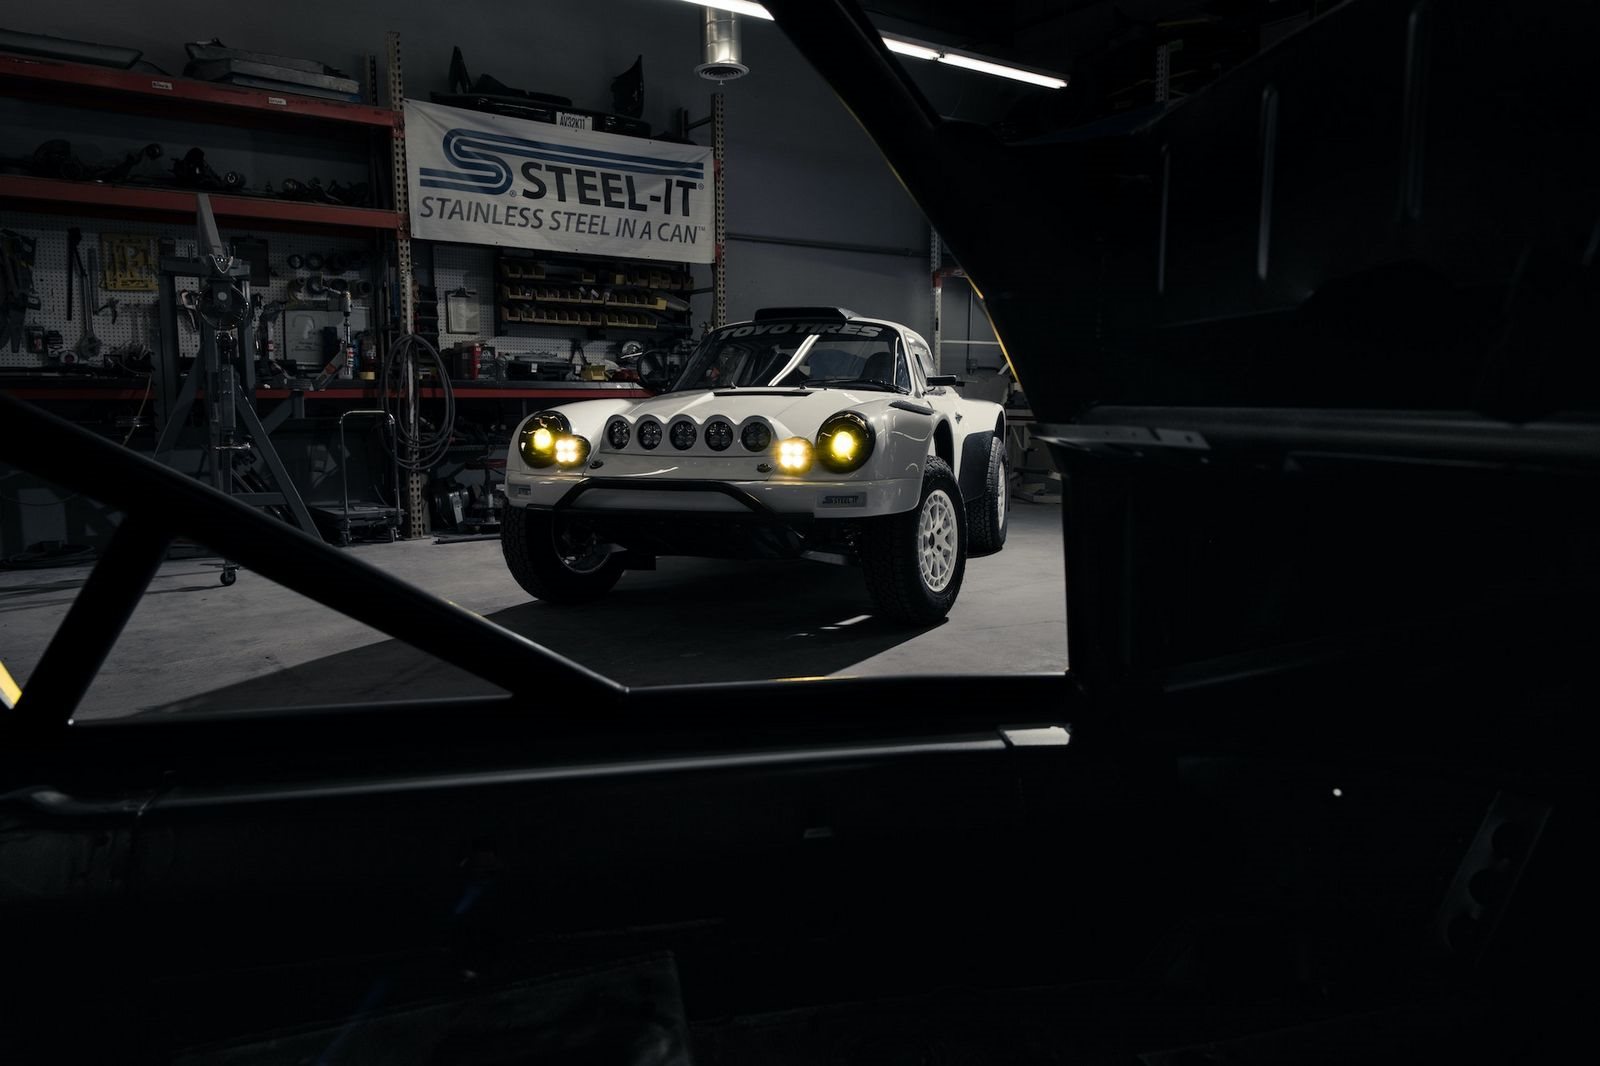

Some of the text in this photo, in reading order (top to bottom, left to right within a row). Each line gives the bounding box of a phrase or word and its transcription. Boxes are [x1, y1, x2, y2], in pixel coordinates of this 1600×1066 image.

[521, 161, 697, 217] STEEL-IT
[420, 196, 698, 244] STAINLESS STEEL IN A CAN
[718, 322, 884, 341] TOYO TIRES
